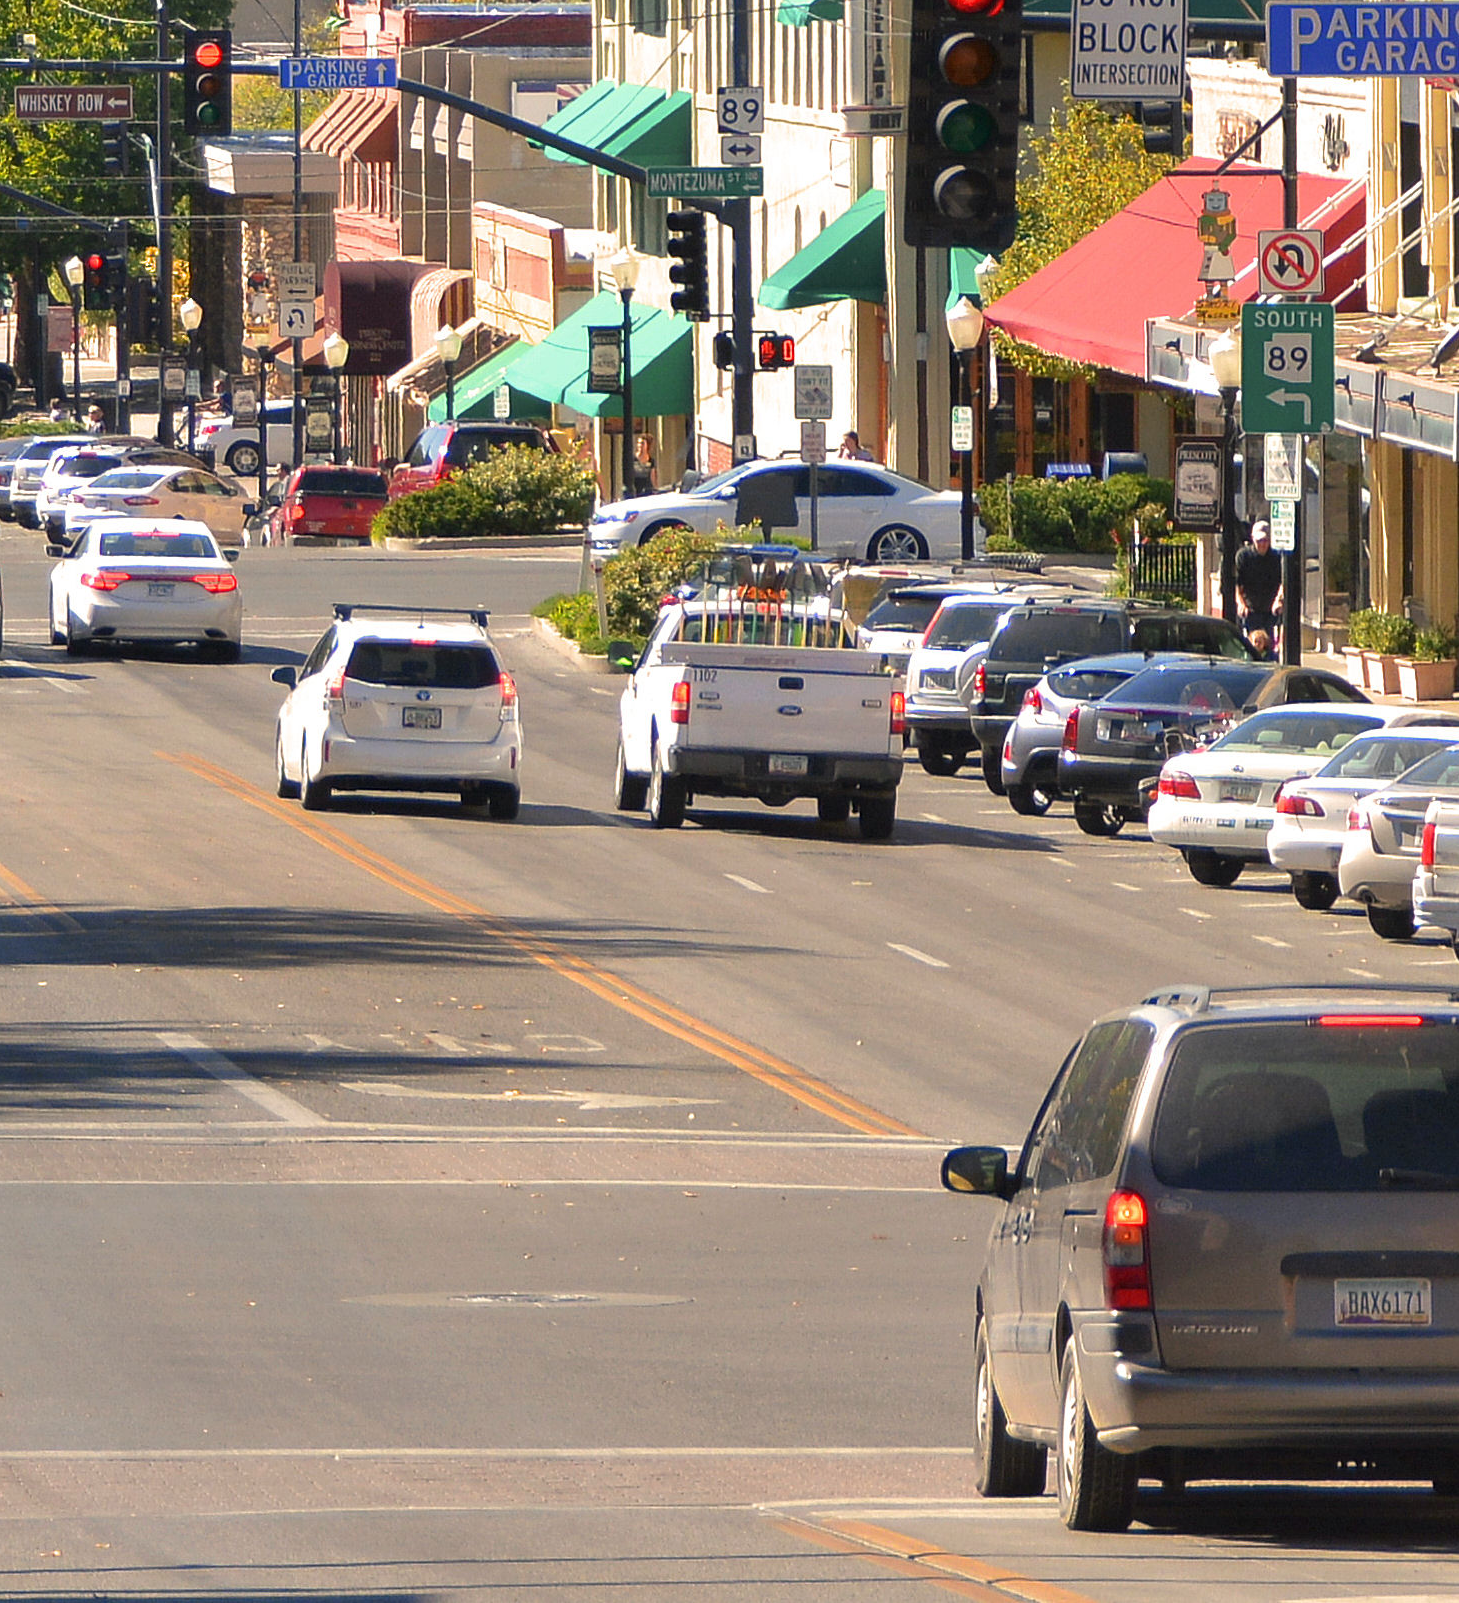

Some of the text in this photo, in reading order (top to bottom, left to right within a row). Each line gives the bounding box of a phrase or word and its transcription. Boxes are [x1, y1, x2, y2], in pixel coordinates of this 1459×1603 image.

[1079, 22, 1179, 54] BLOCK
[288, 60, 367, 87] PARKING
[307, 73, 367, 87] GARAGE
[1076, 63, 1179, 86] INTERSECTION
[18, 93, 103, 112] WHISKEY ROW
[722, 98, 759, 125] 89
[650, 173, 725, 192] MONTEZUMA
[728, 173, 740, 182] ST
[1254, 310, 1323, 328] SOUTH
[1268, 346, 1309, 372] 89
[692, 670, 717, 683] 1102
[1348, 1290, 1426, 1315] BAX6171
